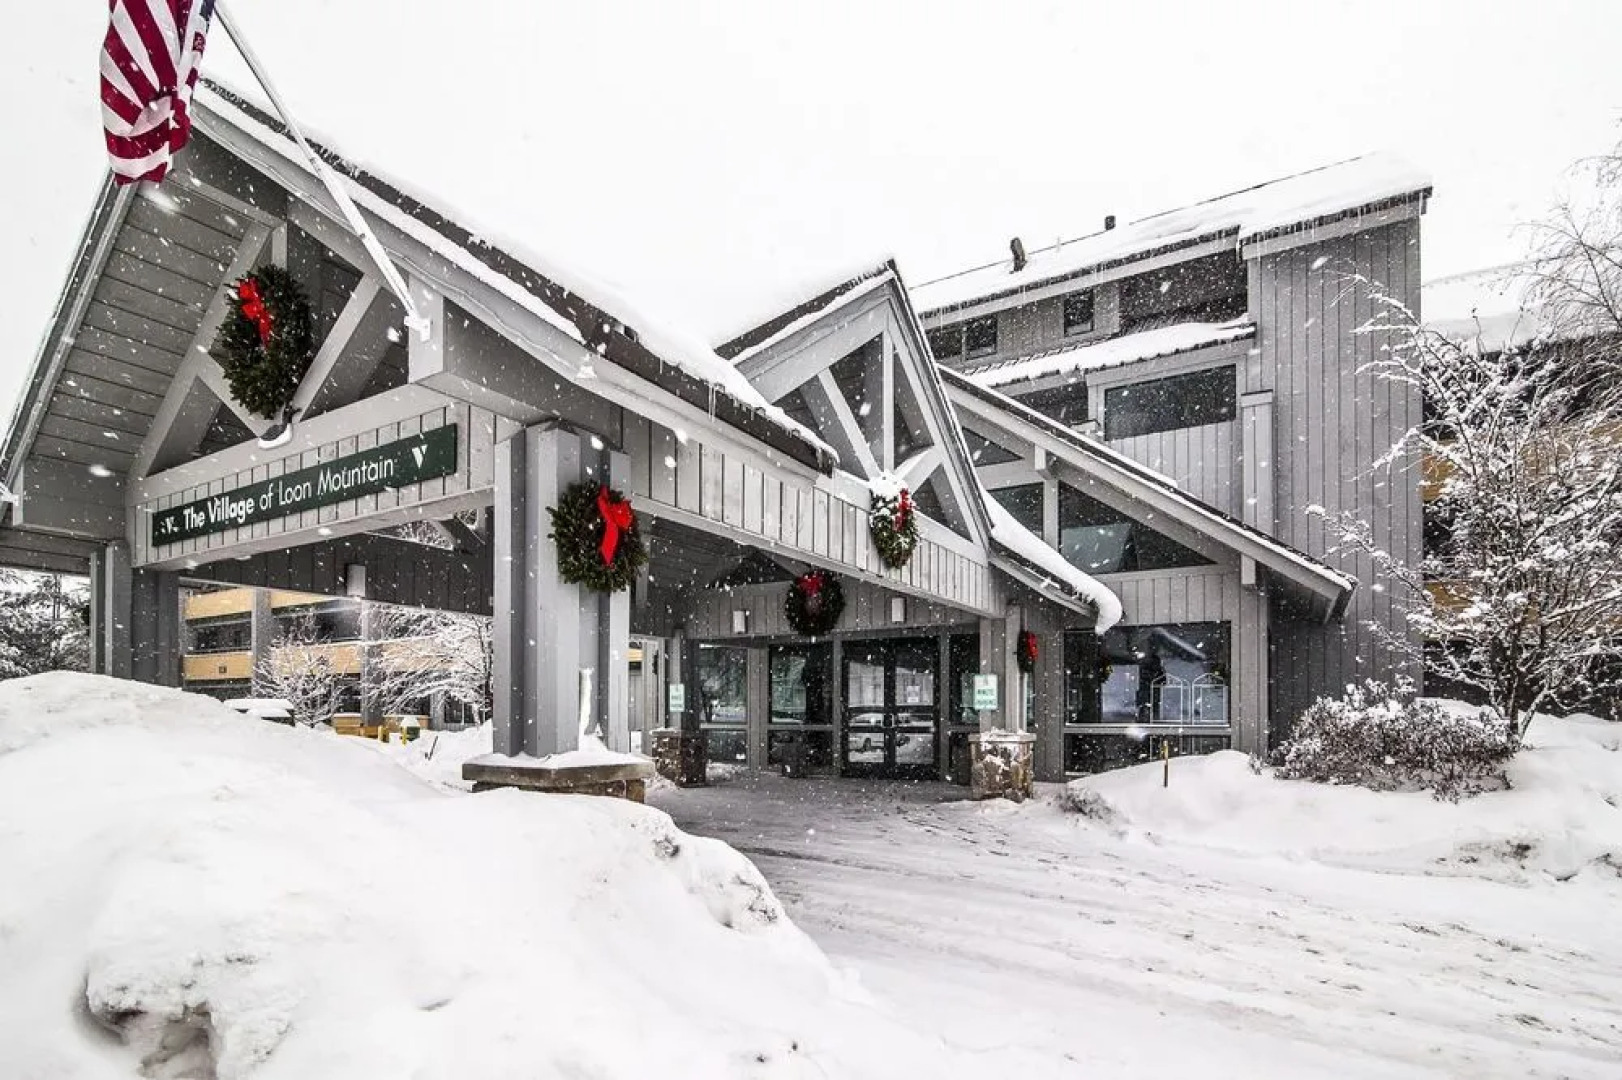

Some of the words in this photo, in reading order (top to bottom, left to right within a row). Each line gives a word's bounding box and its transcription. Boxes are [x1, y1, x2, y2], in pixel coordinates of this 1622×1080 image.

[183, 506, 206, 531] The
[207, 496, 255, 524] Village
[259, 482, 275, 510] of
[279, 480, 313, 506] Loon
[317, 455, 393, 495] Mountain
